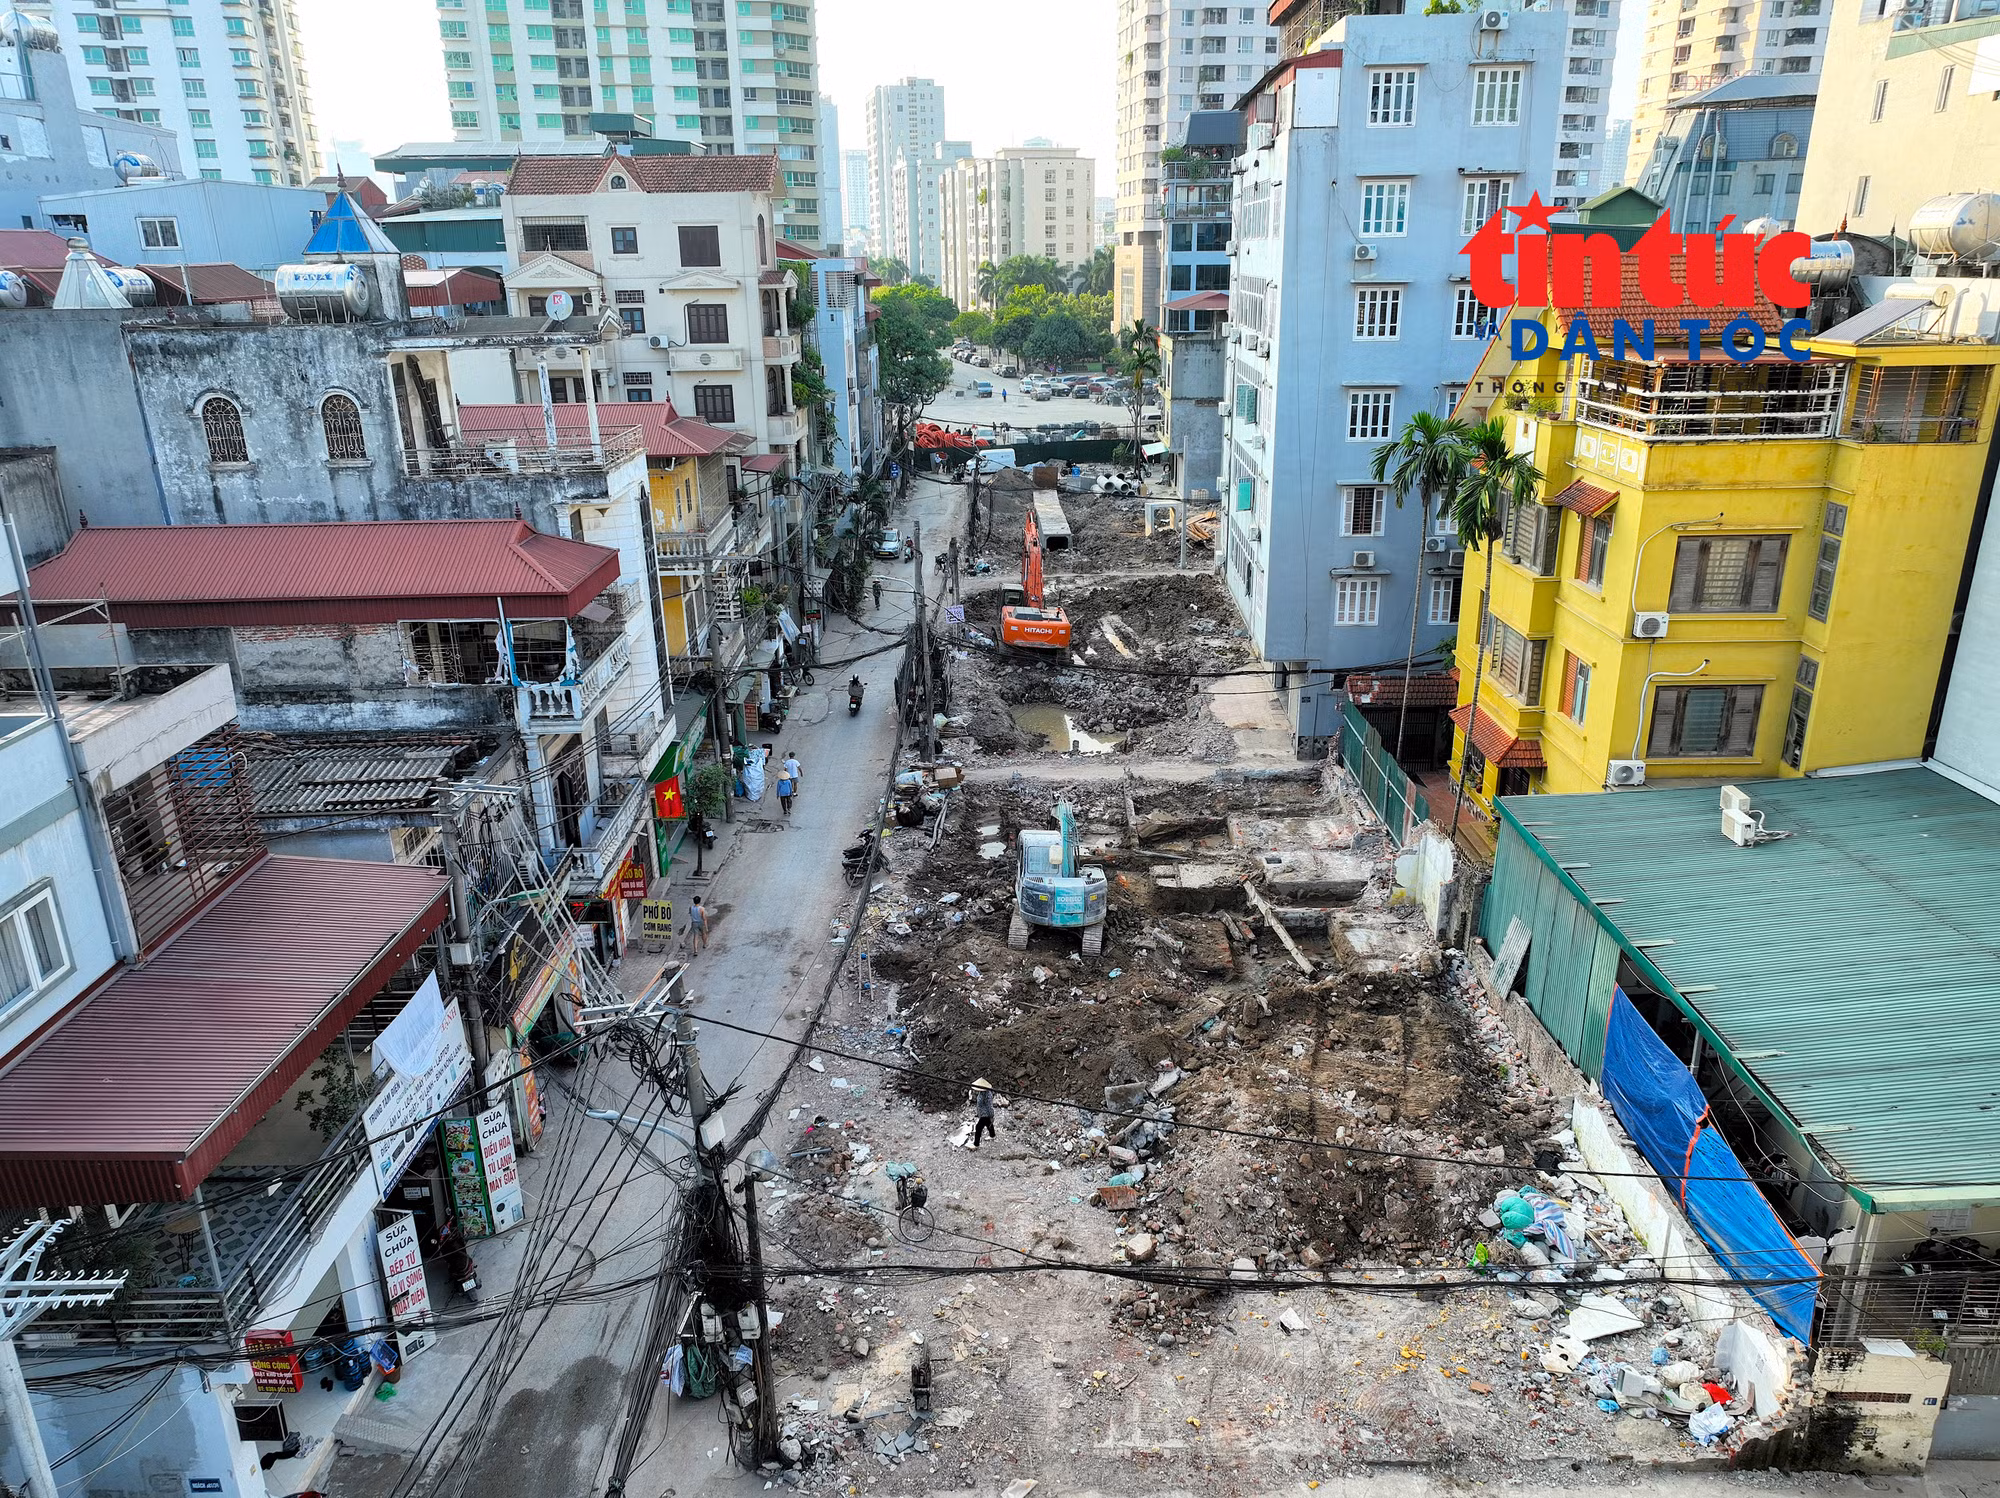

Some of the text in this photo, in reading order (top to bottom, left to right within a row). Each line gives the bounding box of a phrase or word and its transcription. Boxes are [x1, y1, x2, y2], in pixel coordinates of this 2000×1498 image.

[1024, 627, 1052, 635] HITACHI
[643, 901, 672, 920] PHỞ BÒ
[643, 922, 672, 932] CƠM RANG
[483, 1110, 503, 1125] SỬA
[482, 1121, 508, 1139] CHỮA
[483, 1134, 512, 1159] ĐIỀU HÒA
[487, 1158, 496, 1175] TỦ
[489, 1168, 517, 1193] MÁY GIẶT
[385, 1224, 408, 1242] SỬA
[384, 1235, 414, 1258] CHỮA
[389, 1249, 416, 1277] BẾP TỪ
[389, 1268, 423, 1299] LÒ VI SÓNG
[410, 1286, 426, 1306] ĐIỆN
[252, 1360, 290, 1370] CÔNG CỘNG
